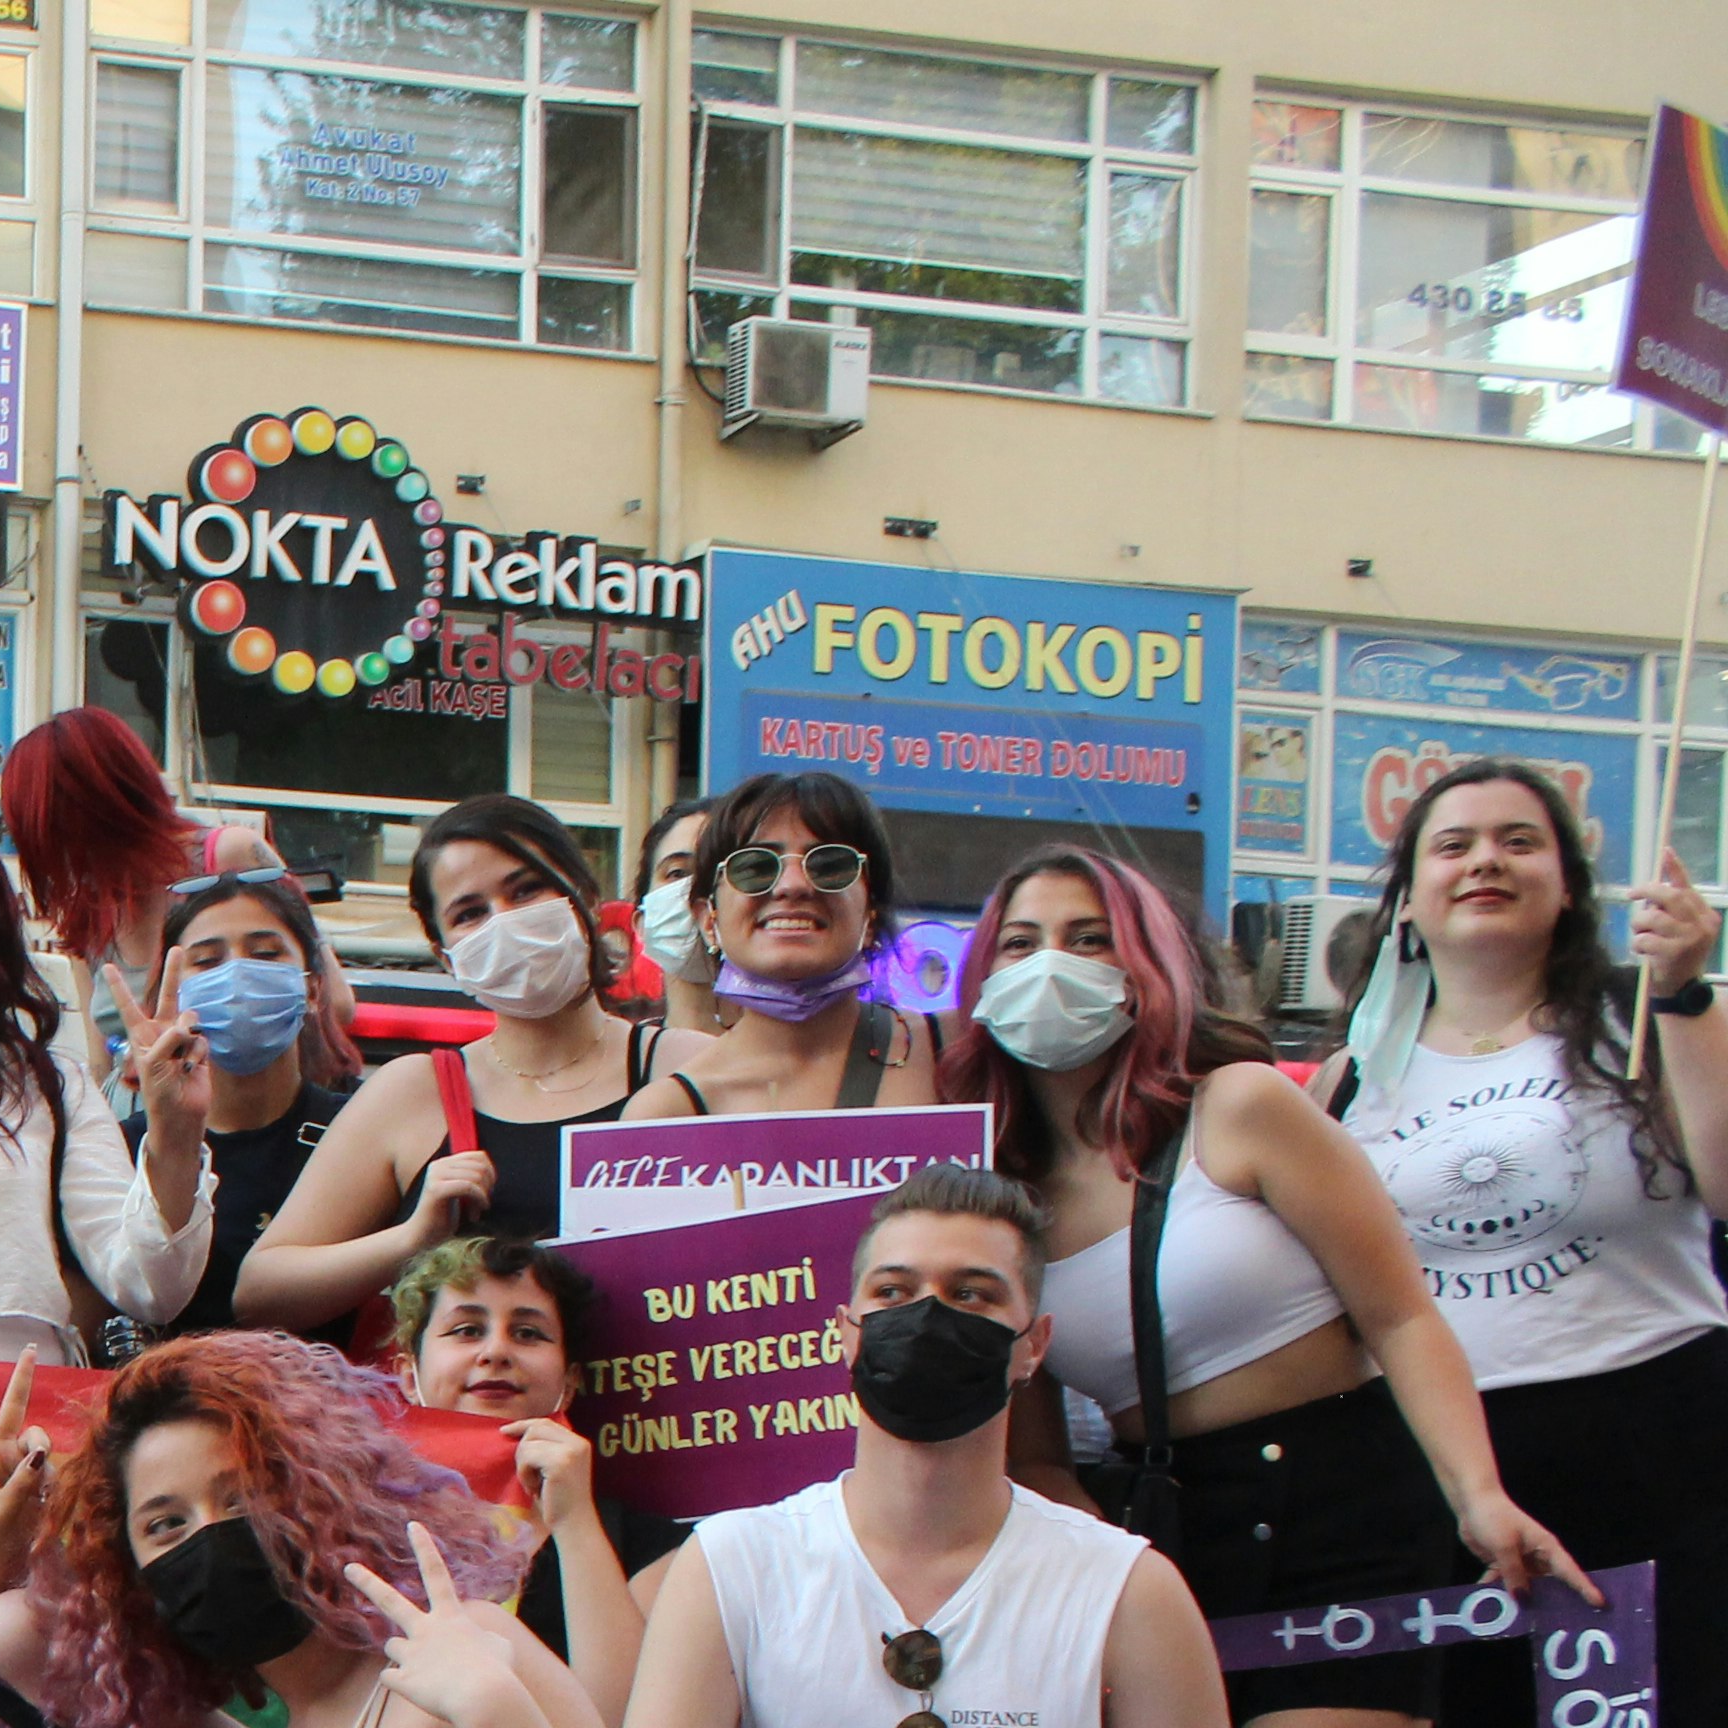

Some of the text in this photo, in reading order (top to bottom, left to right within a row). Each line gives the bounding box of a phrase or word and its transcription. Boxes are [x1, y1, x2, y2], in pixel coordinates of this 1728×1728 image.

[313, 122, 417, 153] Avukat
[280, 146, 449, 189] Ahmet Ulusoy
[346, 182, 360, 200] 2
[397, 187, 422, 208] 57
[113, 494, 701, 623] NOKTA Reklam
[730, 588, 1204, 705] AHU FOTOKOPİ
[428, 683, 509, 722] KAŞE
[760, 716, 1187, 788] KARTUŞ ve TONER DOLUMU
[1391, 1109, 1436, 1142] LE
[643, 1256, 816, 1324] BU KENTİ
[580, 1350, 678, 1403] TEŞE
[598, 1407, 738, 1457] GÜNLER
[950, 1709, 1040, 1727] DISTANCE
